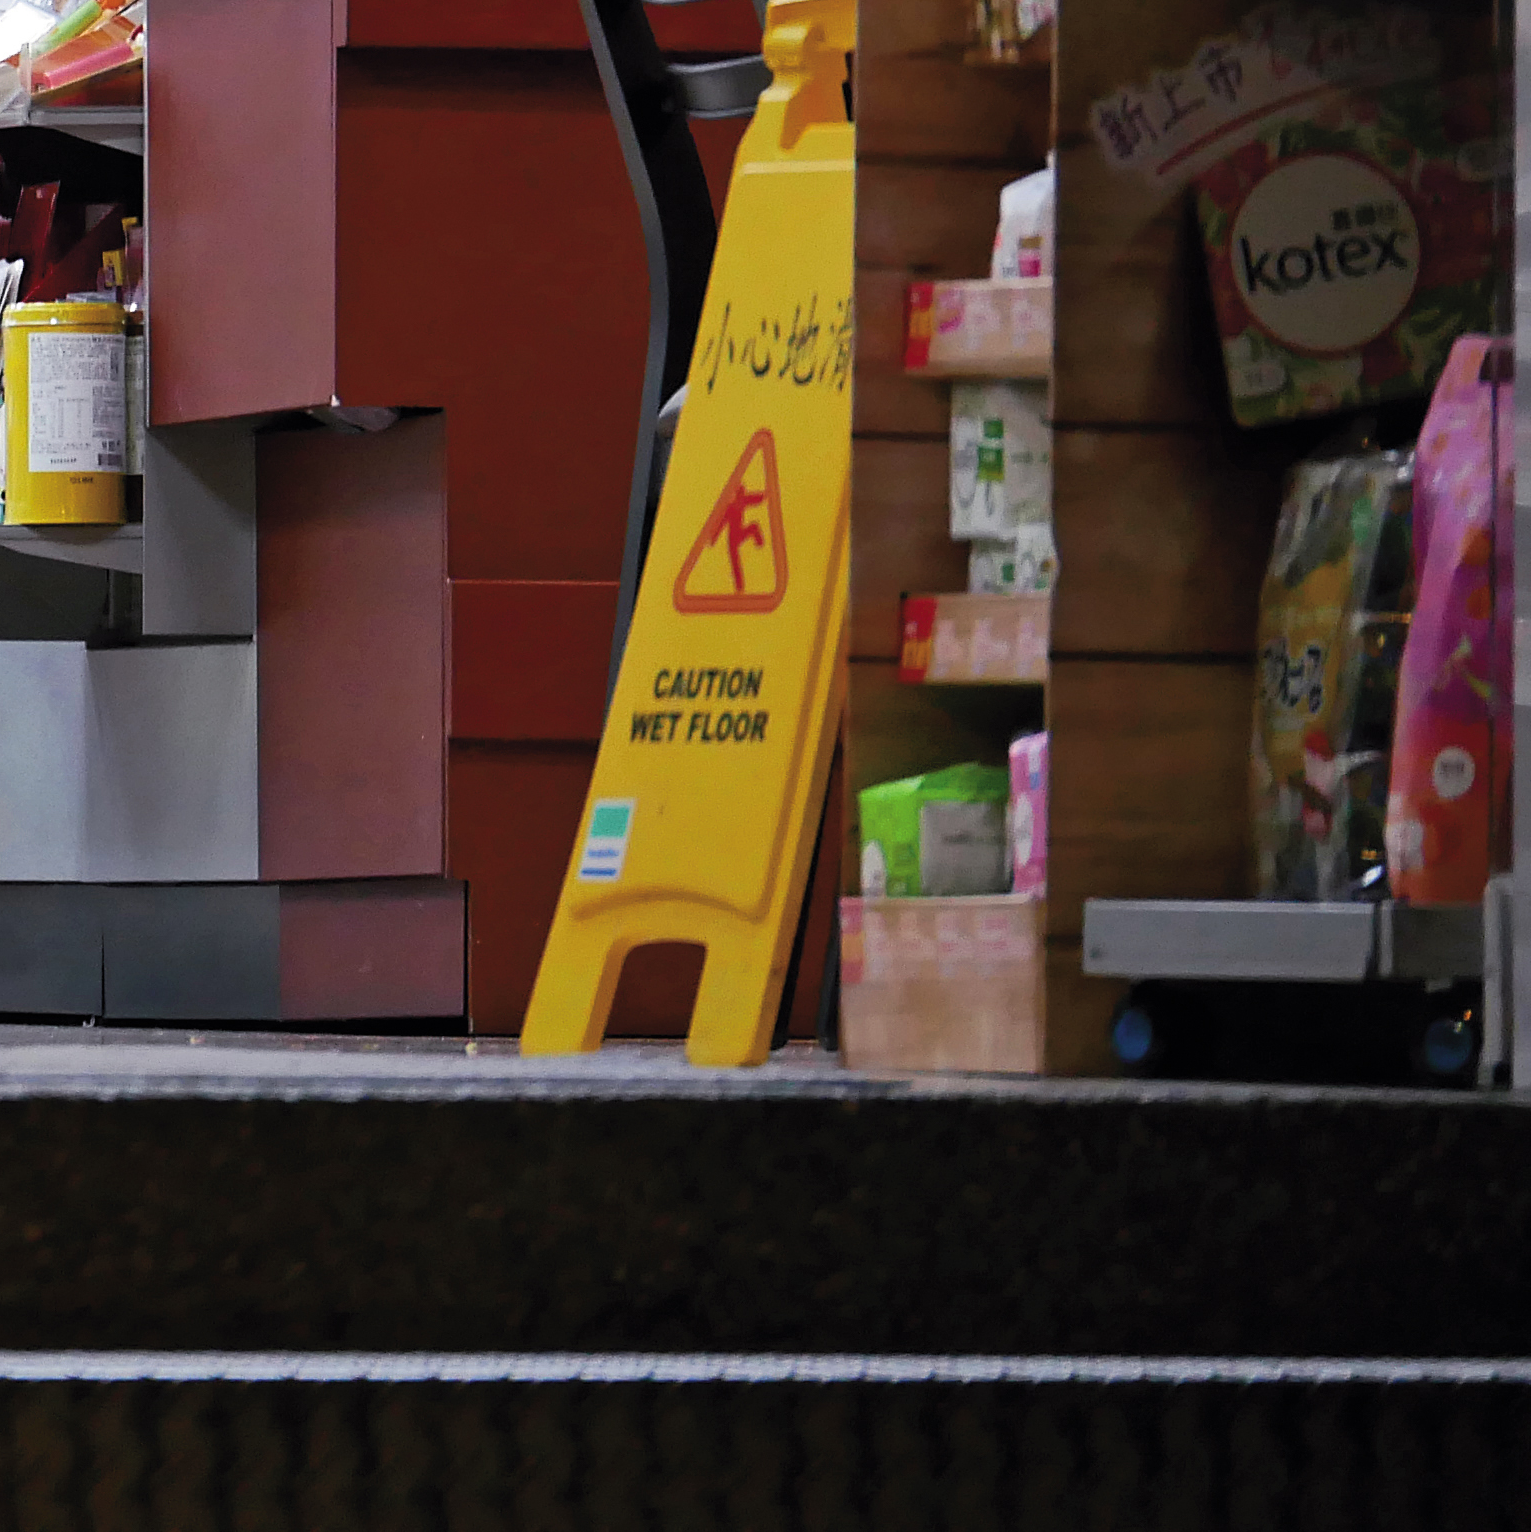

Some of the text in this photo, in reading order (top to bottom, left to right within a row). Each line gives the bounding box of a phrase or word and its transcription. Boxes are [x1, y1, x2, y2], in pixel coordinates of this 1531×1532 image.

[1239, 227, 1409, 297] kotex
[653, 669, 764, 700] CAUTION
[629, 709, 769, 743] WET FLOOR
